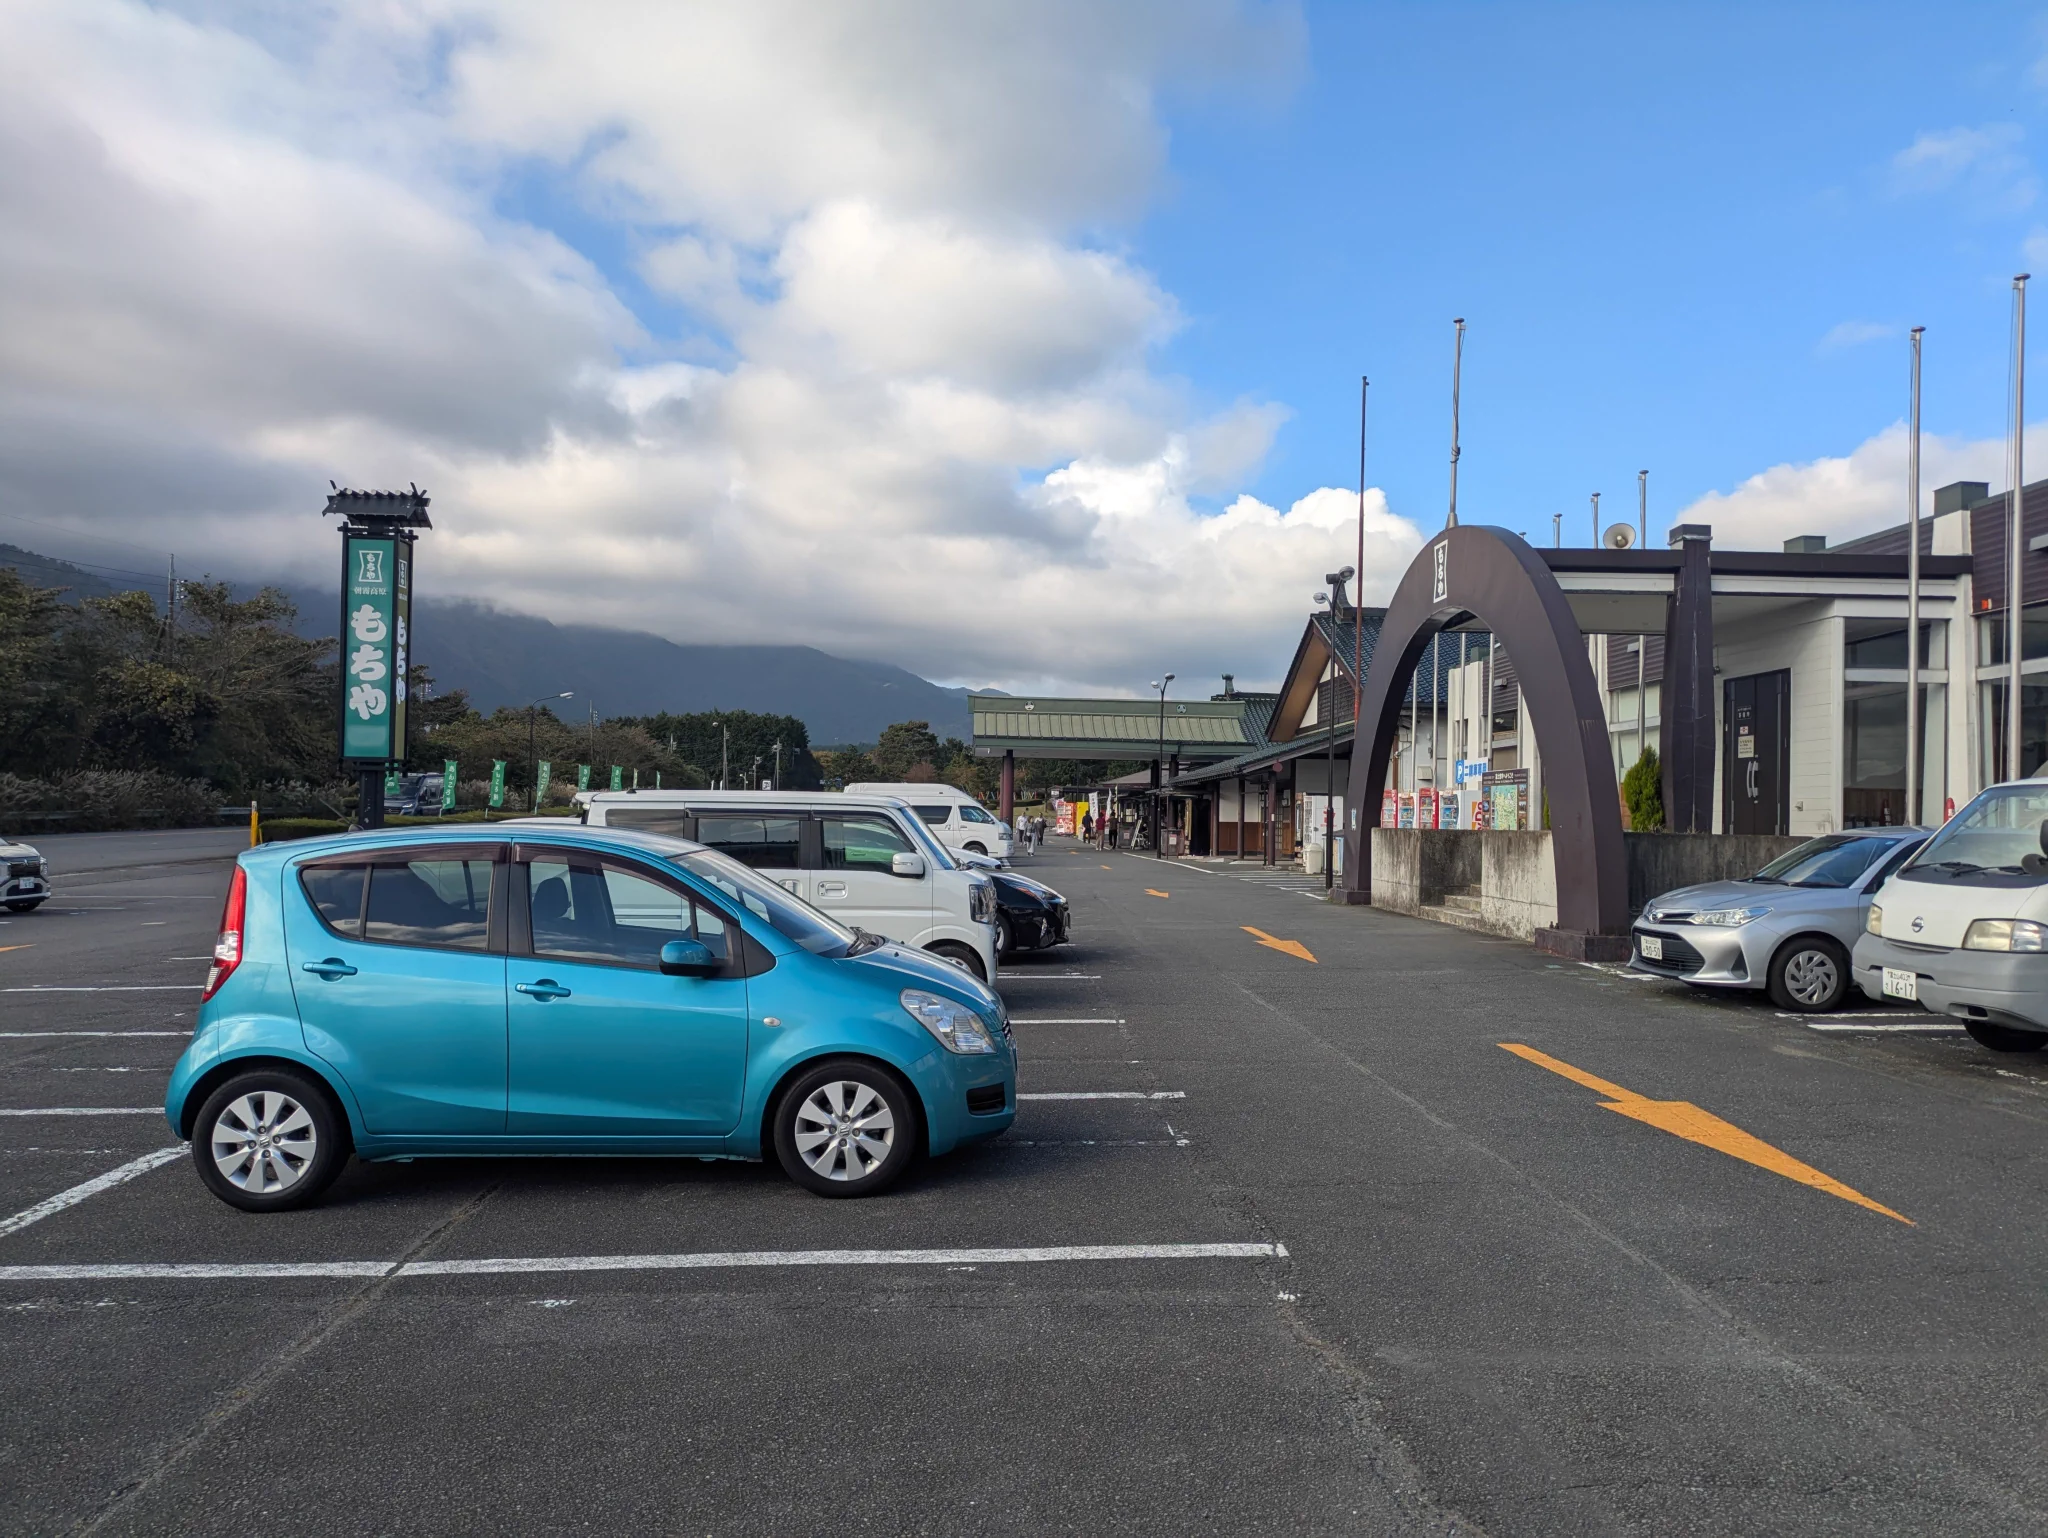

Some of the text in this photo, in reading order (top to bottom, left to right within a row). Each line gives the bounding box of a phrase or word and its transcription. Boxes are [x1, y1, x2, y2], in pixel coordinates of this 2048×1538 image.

[366, 553, 376, 580] もちや
[349, 604, 387, 720] もちや
[396, 615, 407, 704] もちや
